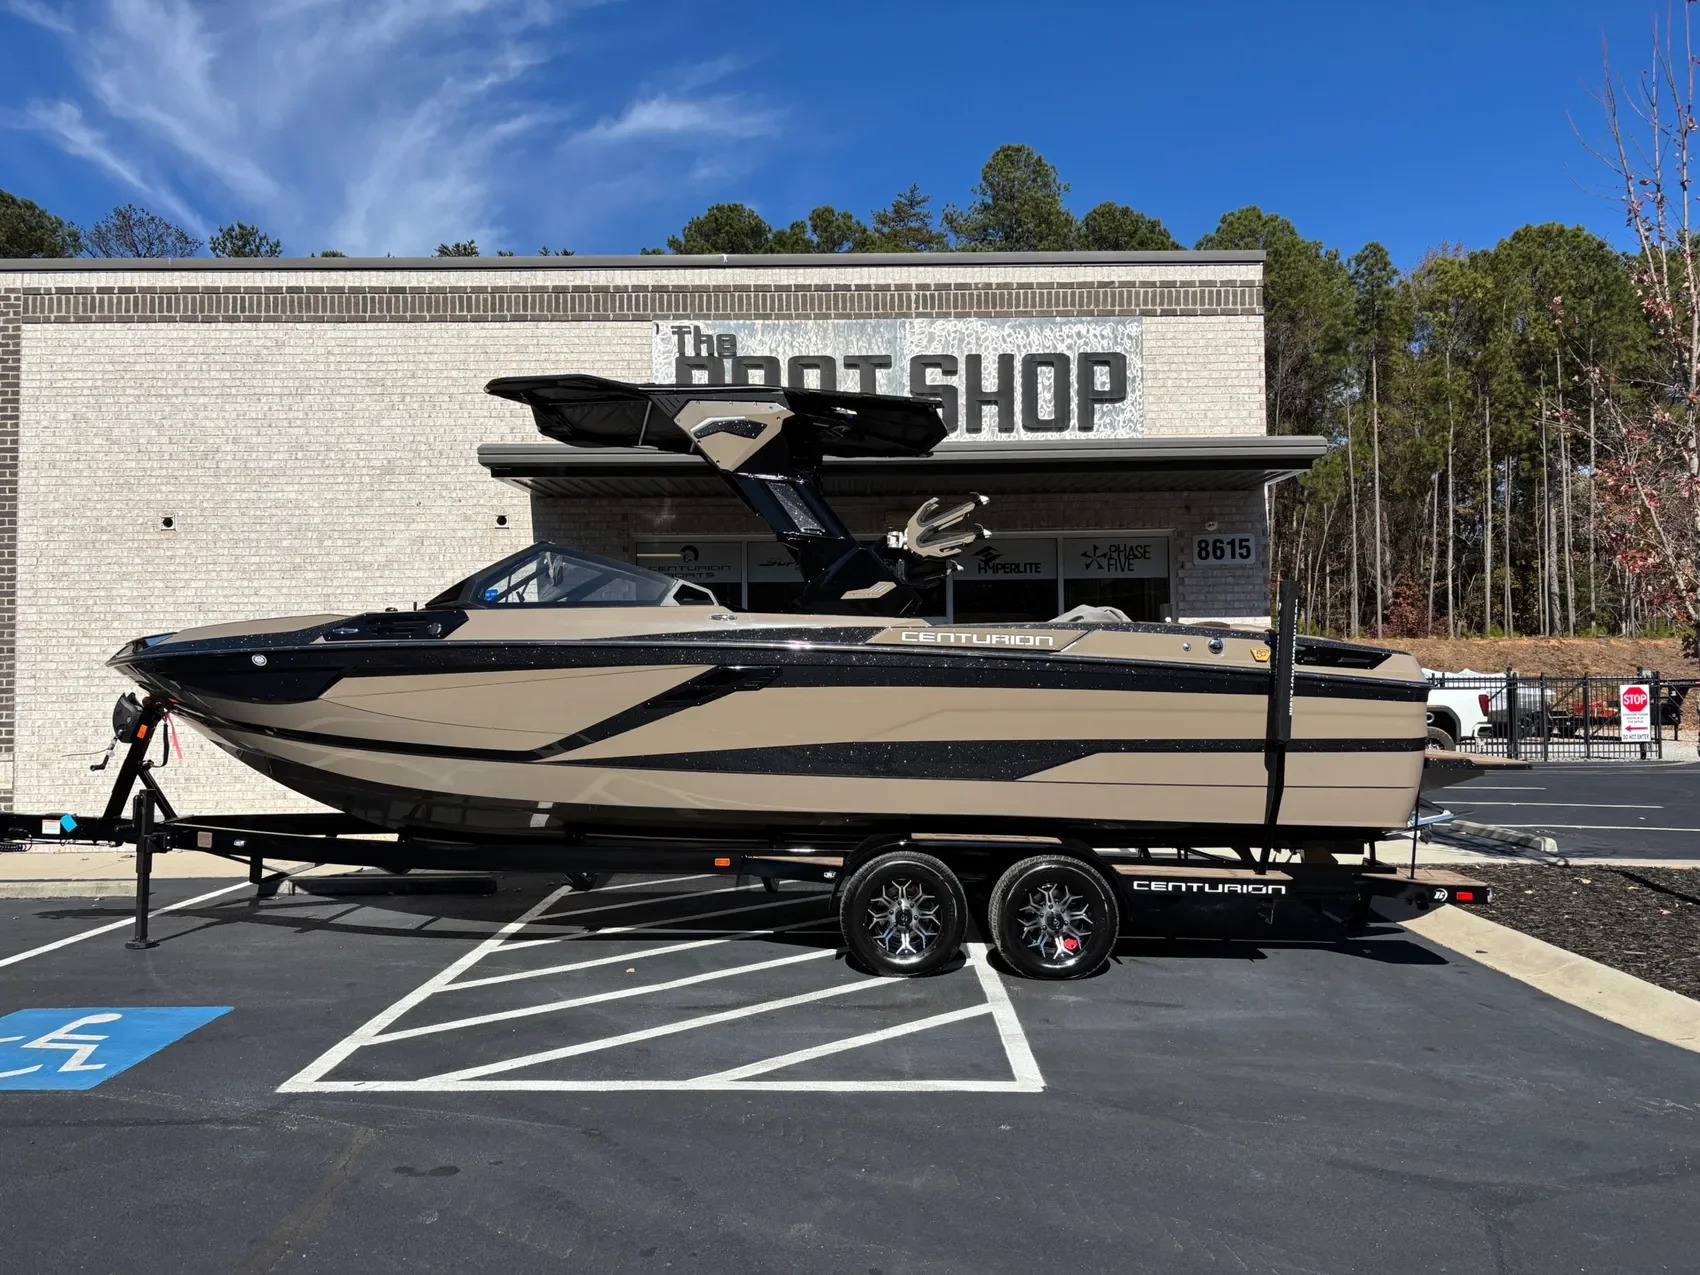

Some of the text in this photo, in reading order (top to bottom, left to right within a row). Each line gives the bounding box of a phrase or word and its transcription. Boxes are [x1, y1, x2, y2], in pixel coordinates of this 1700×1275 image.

[671, 325, 737, 356] The
[909, 353, 1128, 433] SHOP
[1109, 543, 1152, 560] PHASE
[1197, 538, 1252, 560] 8615
[977, 562, 1042, 574] HYPERLITE
[1107, 557, 1135, 573] FIVE
[901, 631, 1054, 647] CENTURION
[1623, 694, 1647, 705] STOP
[1133, 880, 1286, 895] CENTURION
